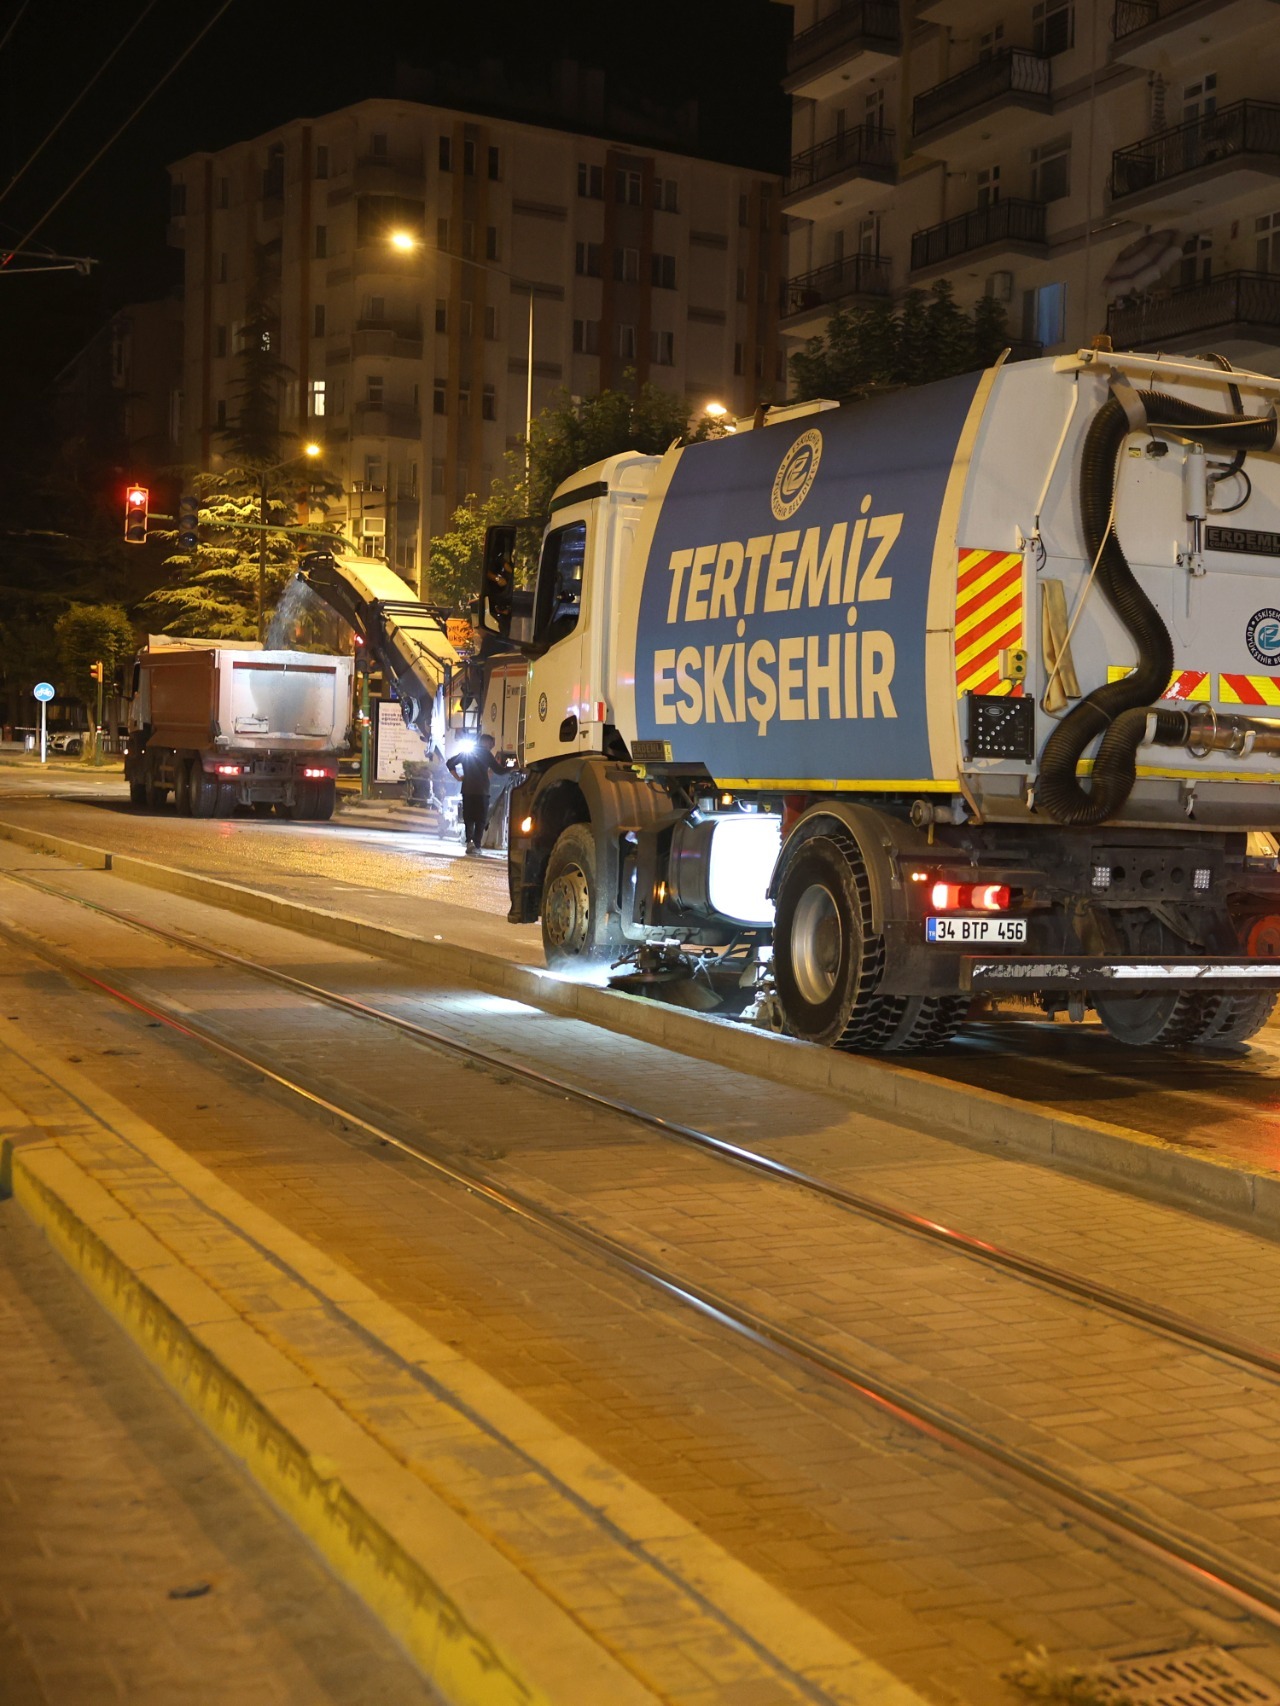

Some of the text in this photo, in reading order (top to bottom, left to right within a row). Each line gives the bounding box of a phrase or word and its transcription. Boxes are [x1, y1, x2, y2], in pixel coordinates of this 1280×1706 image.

[666, 494, 905, 624] TERTEMİZ
[654, 606, 898, 736] ESKİŞEHİR
[1247, 626, 1272, 664] BÜYÜKŞEHİR
[937, 921, 1023, 940] 34 BTP 456
